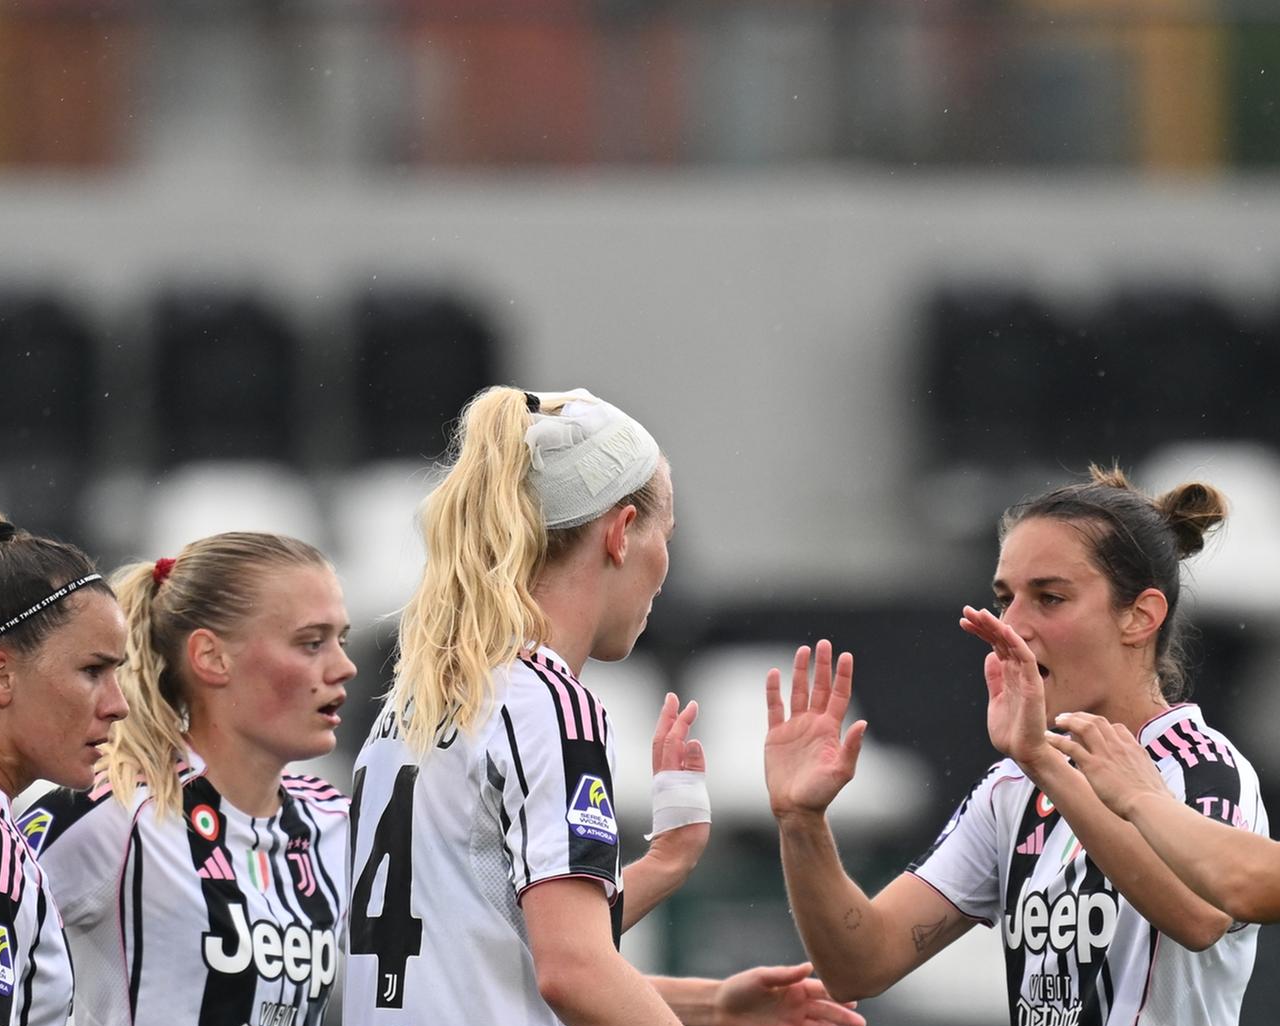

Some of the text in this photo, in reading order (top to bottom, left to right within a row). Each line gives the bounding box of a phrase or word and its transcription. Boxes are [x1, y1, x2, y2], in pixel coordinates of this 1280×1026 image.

[5, 617, 19, 629] THE
[19, 603, 42, 620] THREE
[41, 588, 68, 607] STRIPES
[586, 828, 614, 841] ATHORA
[1005, 877, 1118, 964] Jeep
[204, 902, 337, 999] Jeep
[1029, 974, 1072, 1001] VISIT
